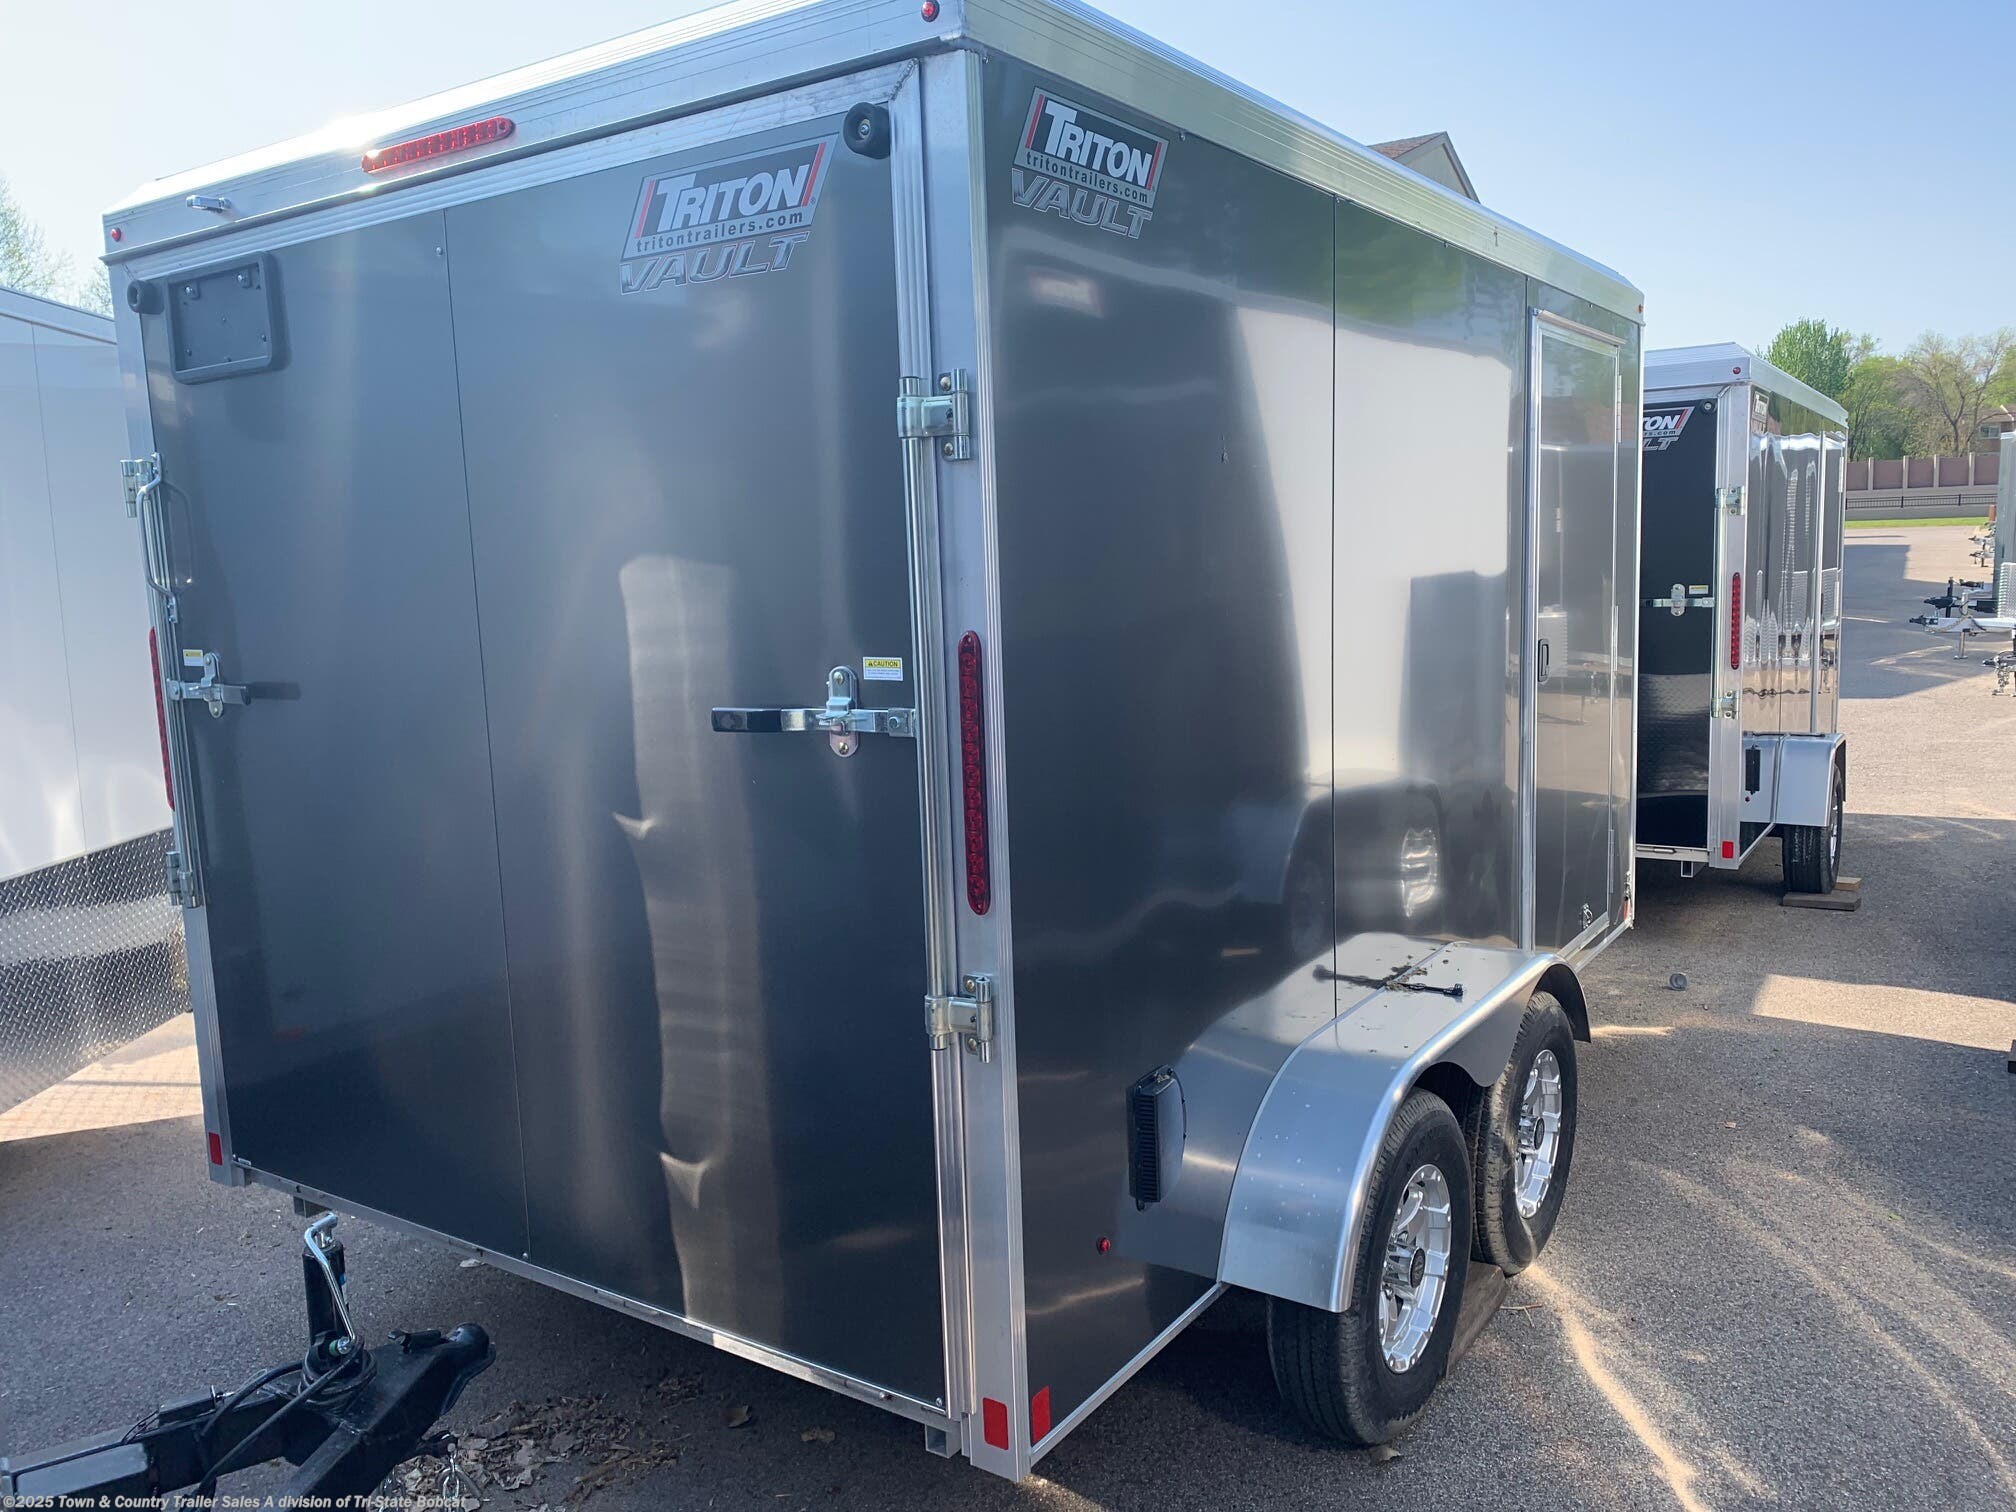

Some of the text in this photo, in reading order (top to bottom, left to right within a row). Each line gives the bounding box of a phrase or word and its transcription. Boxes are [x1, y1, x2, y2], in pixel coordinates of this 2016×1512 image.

[1045, 100, 1152, 186] TRITON
[656, 164, 810, 232] TRITON
[1011, 167, 1154, 239] VAULT
[1026, 151, 1148, 203] tritontrailers.com
[619, 231, 811, 295] VAULT
[636, 211, 803, 252] tritontrailers.com
